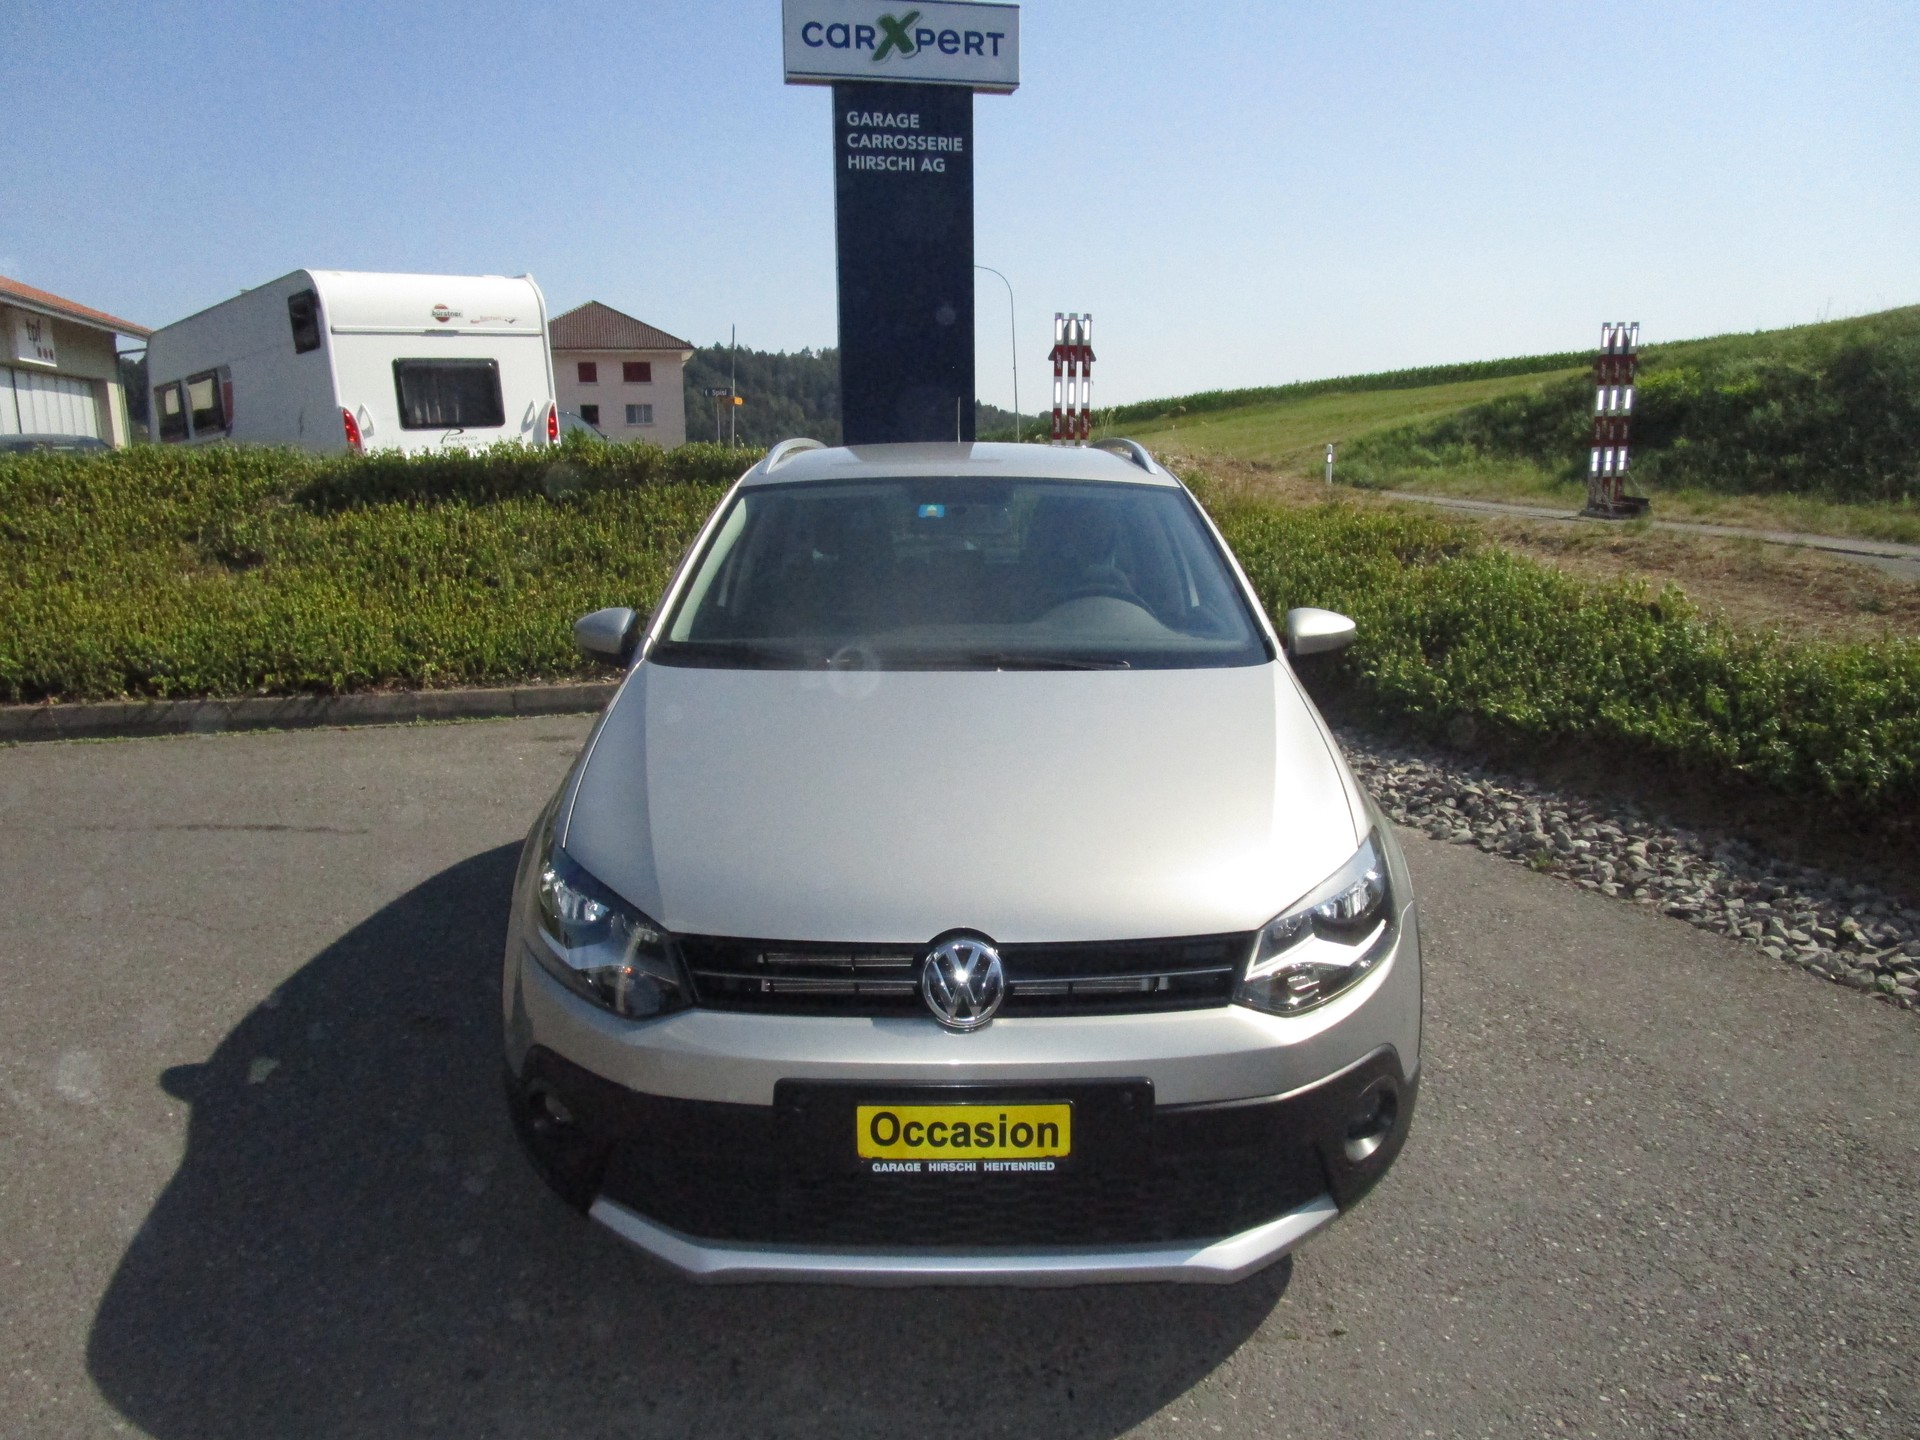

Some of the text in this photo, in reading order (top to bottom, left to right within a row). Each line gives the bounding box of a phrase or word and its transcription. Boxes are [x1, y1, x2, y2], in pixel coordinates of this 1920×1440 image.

[846, 111, 920, 129] GARAGE
[846, 133, 963, 152] CARROSSERIE
[847, 155, 946, 173] HIRSCHI AG
[869, 1111, 1060, 1149] Occasion
[871, 1162, 1056, 1173] GARAGE HIRSCHI HEITENRIED
